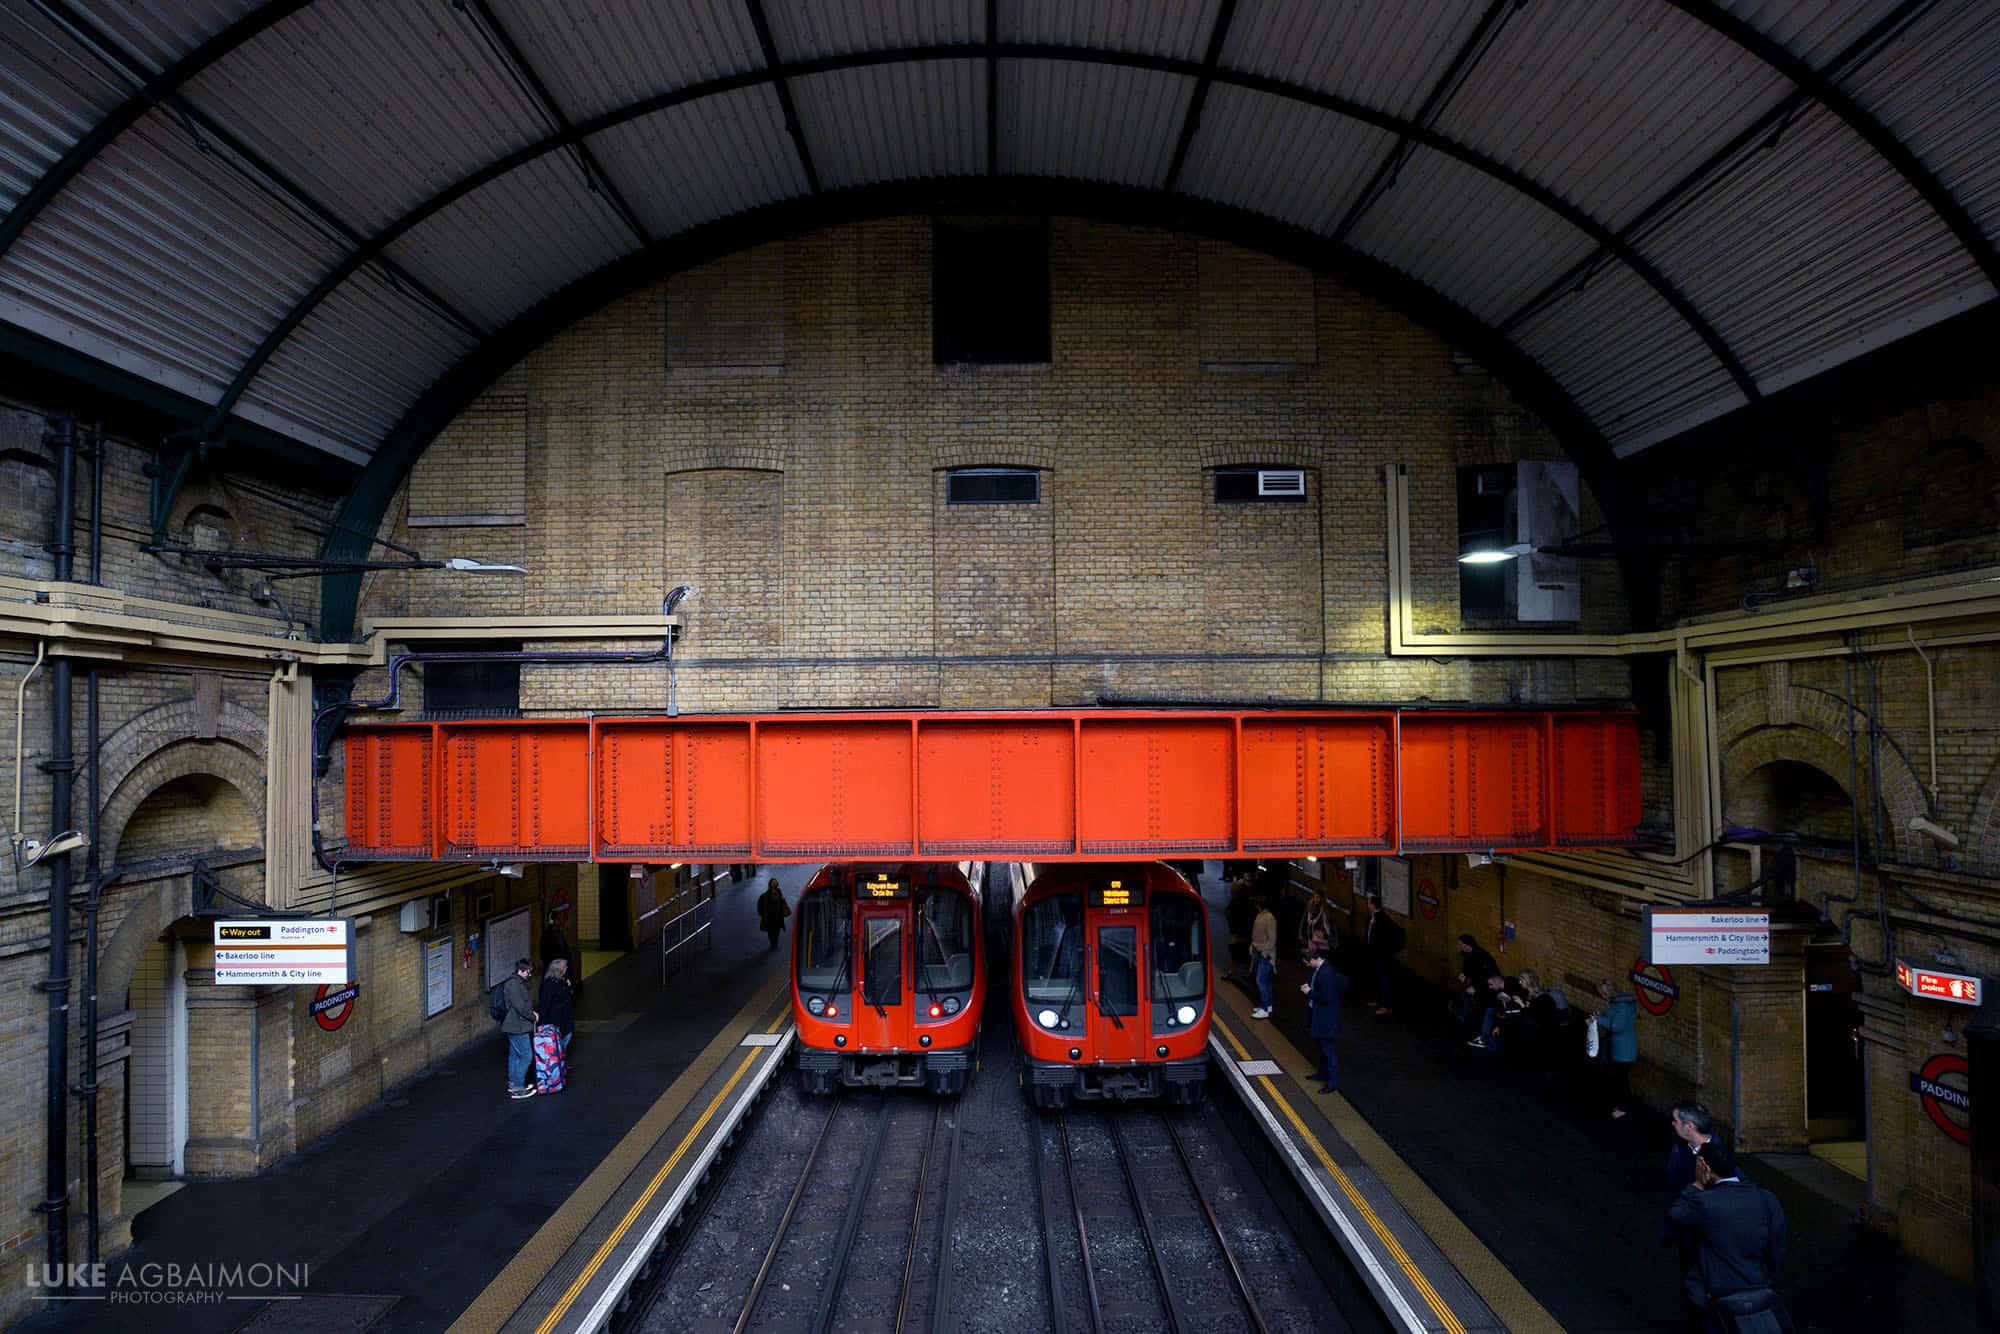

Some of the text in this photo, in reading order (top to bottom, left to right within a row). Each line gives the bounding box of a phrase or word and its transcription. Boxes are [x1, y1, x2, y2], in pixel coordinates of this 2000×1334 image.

[1711, 915, 1760, 923] Bakerloo line
[229, 928, 261, 938] Way out
[281, 925, 325, 935] Paddington
[1666, 934, 1760, 943] Hammersmith & City line
[225, 952, 276, 960] Bakerloo line
[1718, 947, 1760, 956] Paddington
[225, 969, 322, 979] Hammersmith & City line
[1920, 975, 1938, 984] Fire
[1633, 973, 1675, 998] PADDINGTON
[1920, 984, 1947, 993] point
[314, 988, 355, 1012] PADDINGTON
[1920, 1080, 1970, 1108] PADDIN
